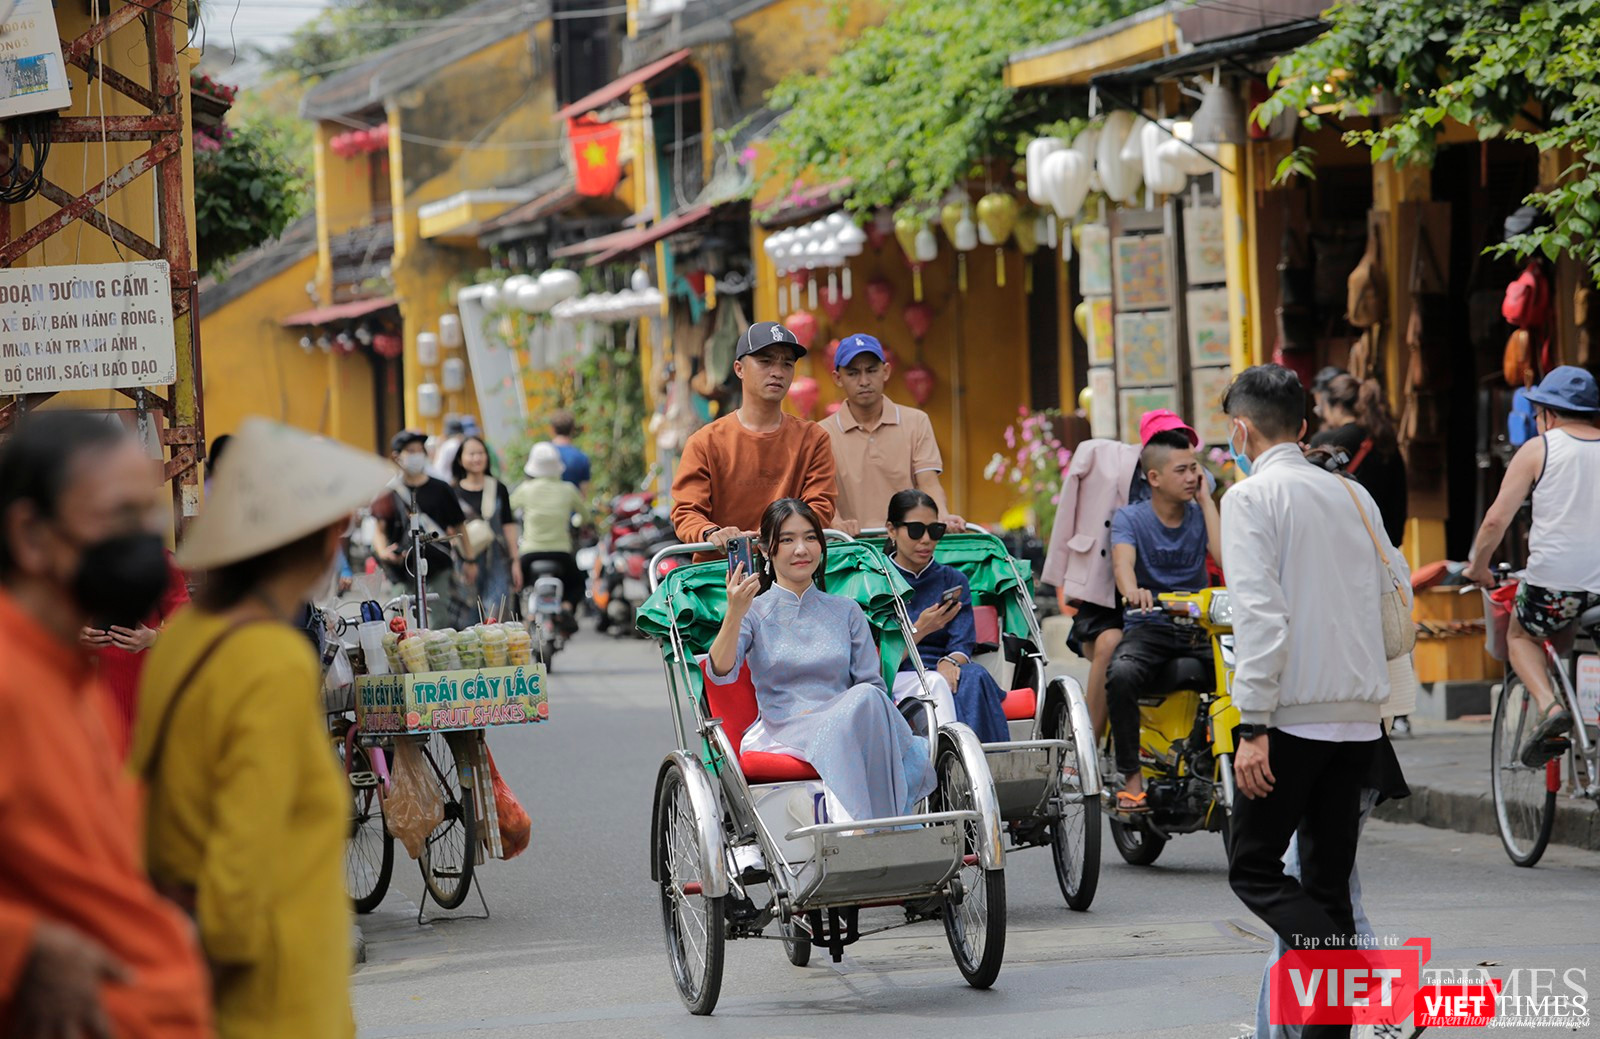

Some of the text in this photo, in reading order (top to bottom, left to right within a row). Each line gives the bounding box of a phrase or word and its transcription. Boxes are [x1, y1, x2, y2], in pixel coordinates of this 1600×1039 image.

[0, 284, 44, 307] ĐOẠN
[49, 276, 106, 301] ĐƯỜNG
[2, 317, 18, 332] XE
[66, 338, 107, 353] TRANH
[111, 333, 137, 352] ẢNH
[5, 363, 22, 383] ĐỒ
[102, 359, 127, 377] BÁO
[131, 359, 158, 378] DẠO
[414, 667, 541, 704] TRÁI CÂY LẮC
[433, 704, 526, 727] FRUIT SHAKES
